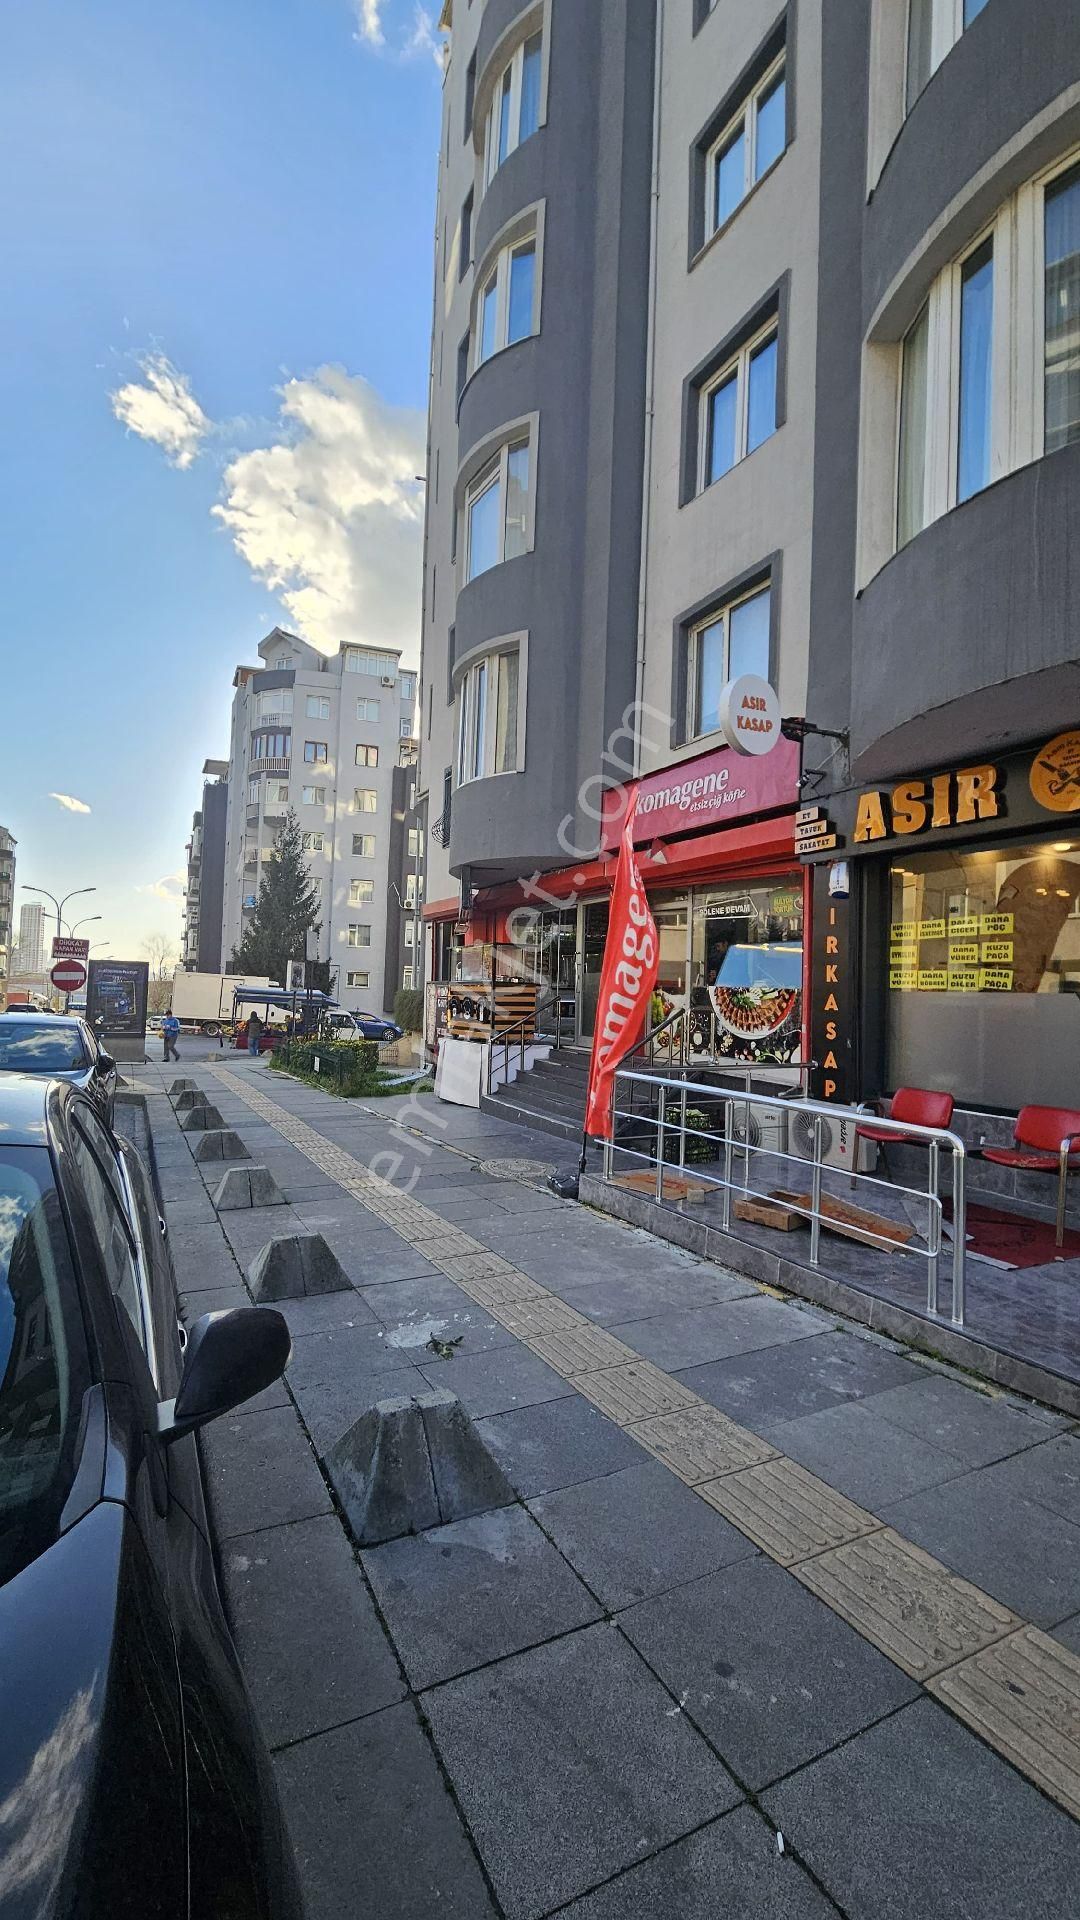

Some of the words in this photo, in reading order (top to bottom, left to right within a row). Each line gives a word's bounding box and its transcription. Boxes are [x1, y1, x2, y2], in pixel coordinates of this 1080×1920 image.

[741, 695, 767, 712] ASIR
[737, 715, 773, 733] KASAP
[635, 768, 729, 816] komagene
[690, 799, 707, 813] etsiz
[854, 764, 998, 843] ASIR
[802, 812, 811, 820] ET
[800, 825, 823, 836] TAVUK
[799, 838, 830, 851] SAKATAT
[725, 903, 751, 914] DEVAM
